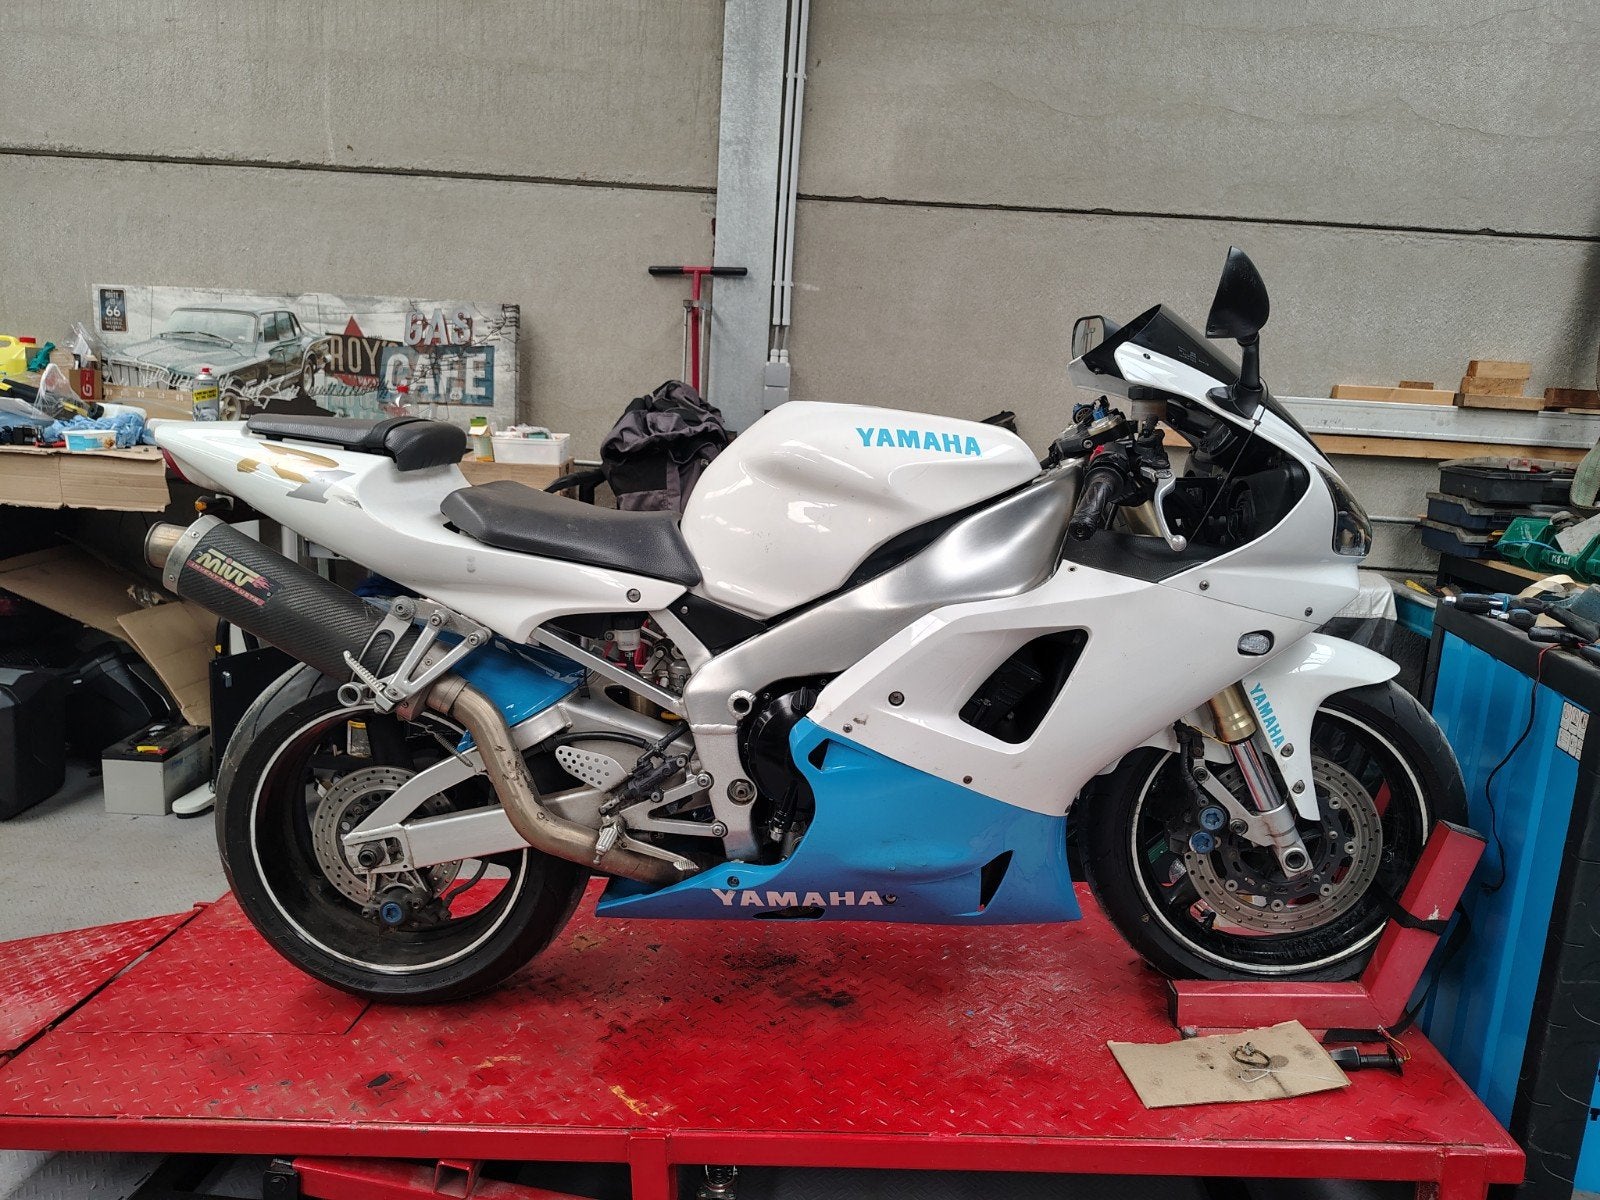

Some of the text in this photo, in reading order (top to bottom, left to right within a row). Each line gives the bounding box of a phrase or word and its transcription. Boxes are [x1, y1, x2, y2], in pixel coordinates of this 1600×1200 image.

[106, 305, 121, 317] 66
[404, 308, 473, 346] GAS
[330, 335, 399, 375] ROY'
[385, 351, 487, 397] CAFE
[856, 428, 981, 456] YAMAHA
[1250, 682, 1285, 749] YAMAHA
[711, 888, 884, 907] YAMAHA
